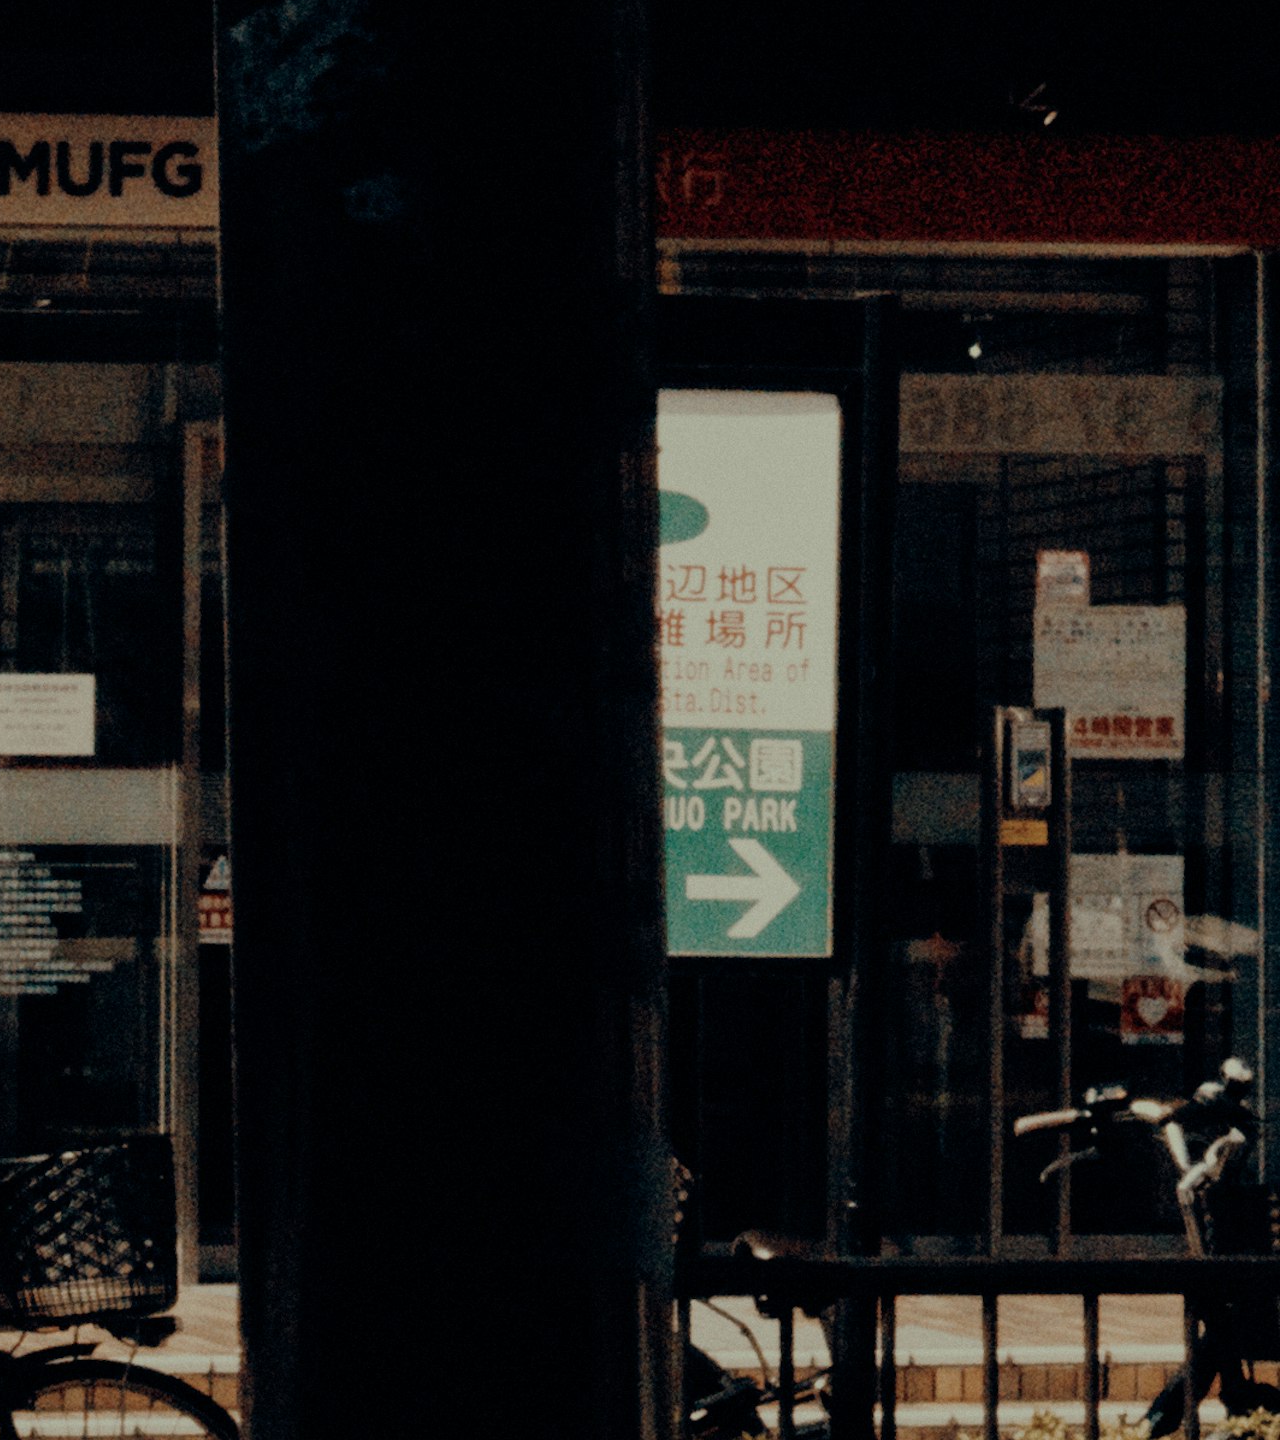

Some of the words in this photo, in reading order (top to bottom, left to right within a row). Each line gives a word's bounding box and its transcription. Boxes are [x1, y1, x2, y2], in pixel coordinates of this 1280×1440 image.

[665, 564, 809, 605] 辺地区
[724, 656, 773, 682] Area
[786, 656, 810, 682] of
[724, 796, 798, 833] PARK
